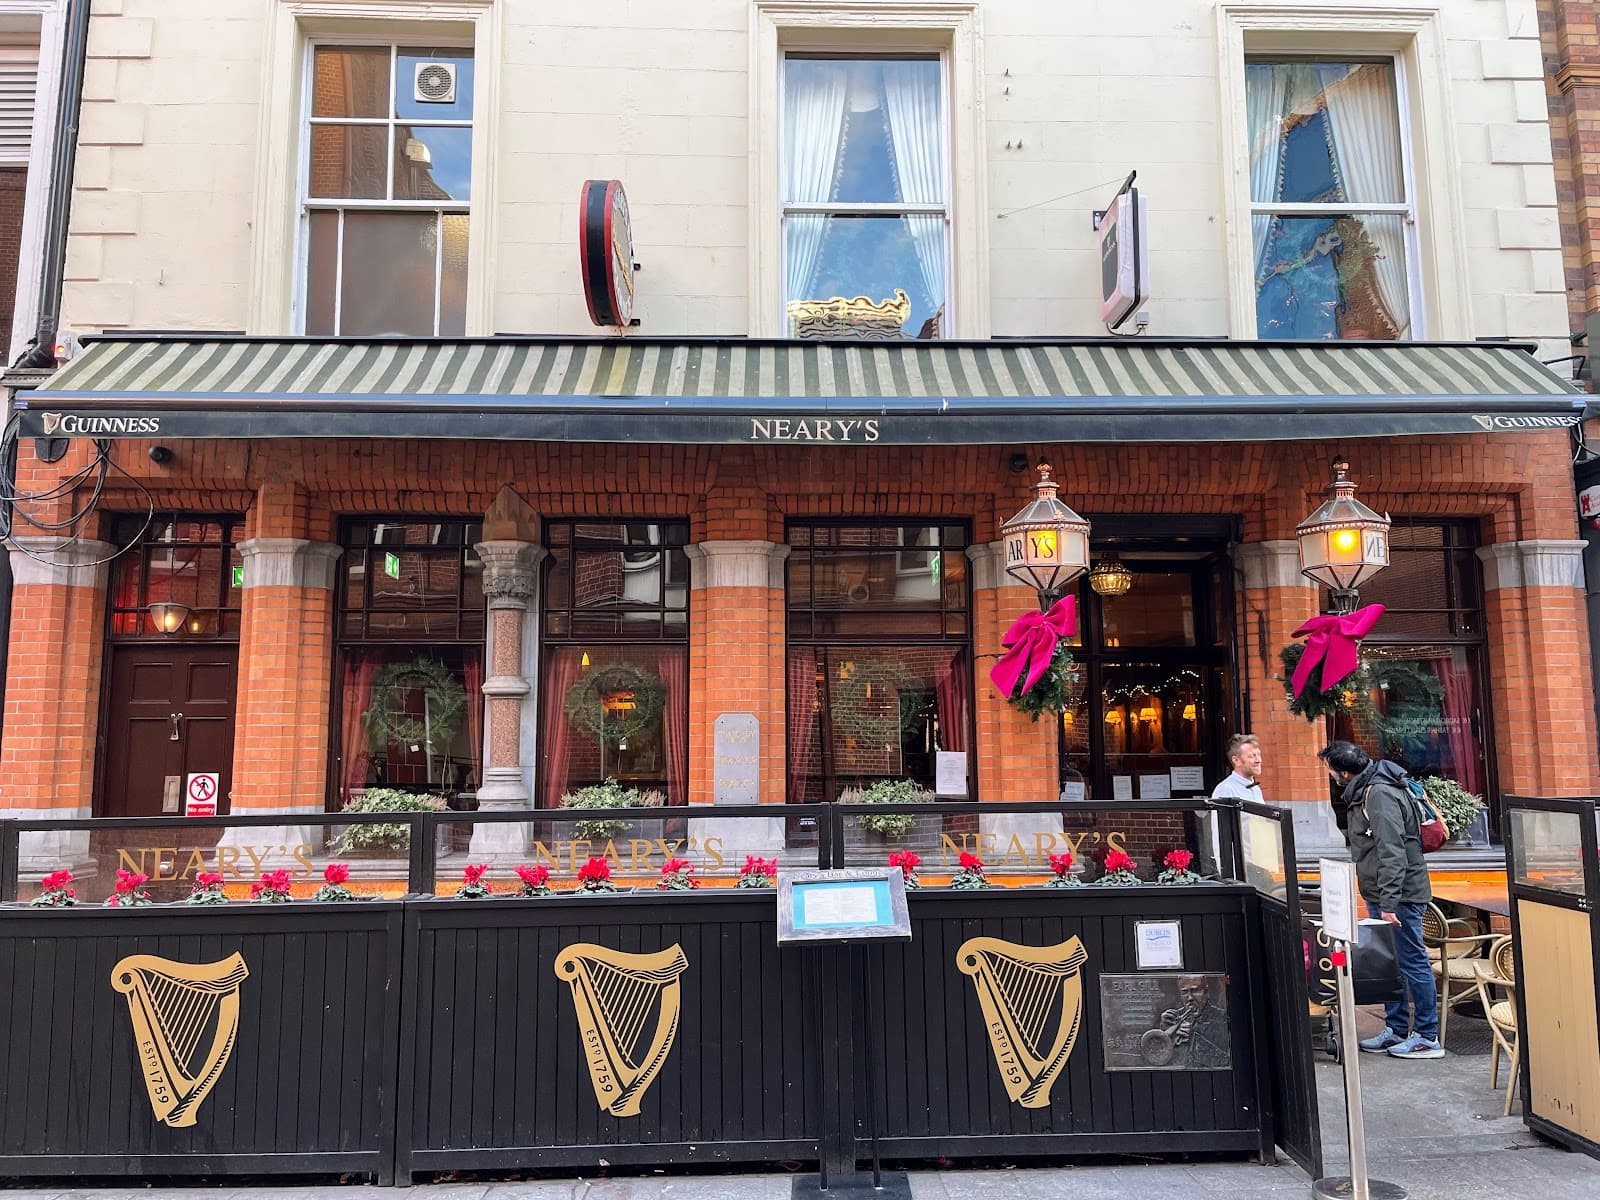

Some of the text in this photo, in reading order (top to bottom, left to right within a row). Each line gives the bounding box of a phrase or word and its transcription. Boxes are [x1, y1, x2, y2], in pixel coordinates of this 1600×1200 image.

[60, 415, 160, 433] GUINNESS
[750, 418, 879, 442] NEARY'S
[116, 844, 314, 882] NEARY'S
[534, 838, 724, 873] NEARY'S
[940, 831, 1126, 867] NEARY'S
[593, 1059, 614, 1093] 1759
[1000, 1051, 1022, 1084] 1759
[149, 1070, 169, 1103] 1759
